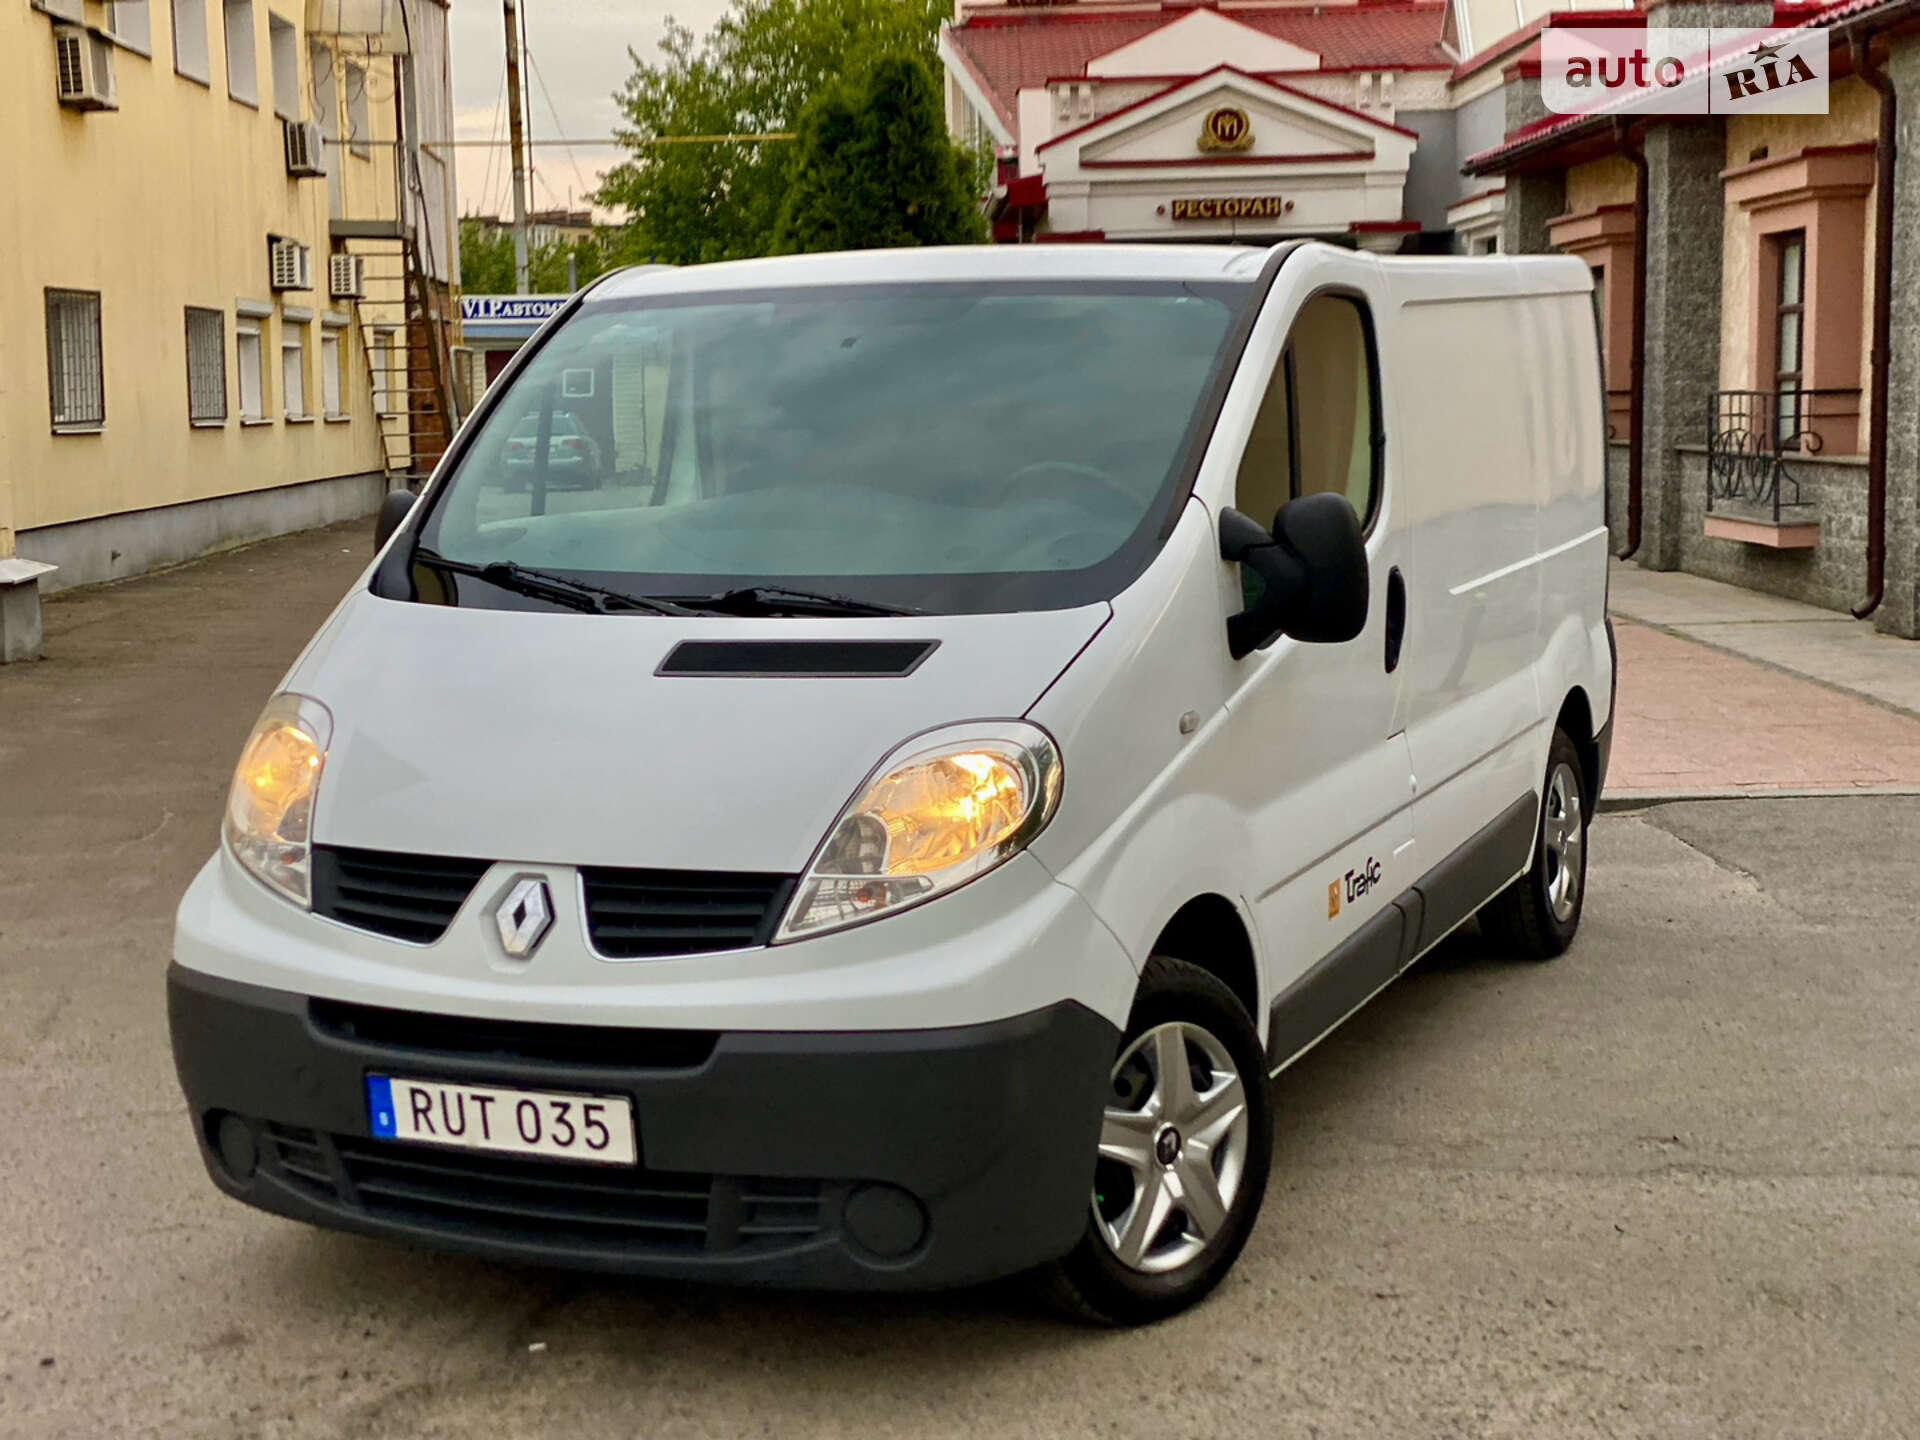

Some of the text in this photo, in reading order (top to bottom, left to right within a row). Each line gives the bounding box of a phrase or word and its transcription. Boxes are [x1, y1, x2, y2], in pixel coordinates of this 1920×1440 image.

[1174, 198, 1280, 217] РЕСТОРАН
[409, 1087, 610, 1150] RUT 035
